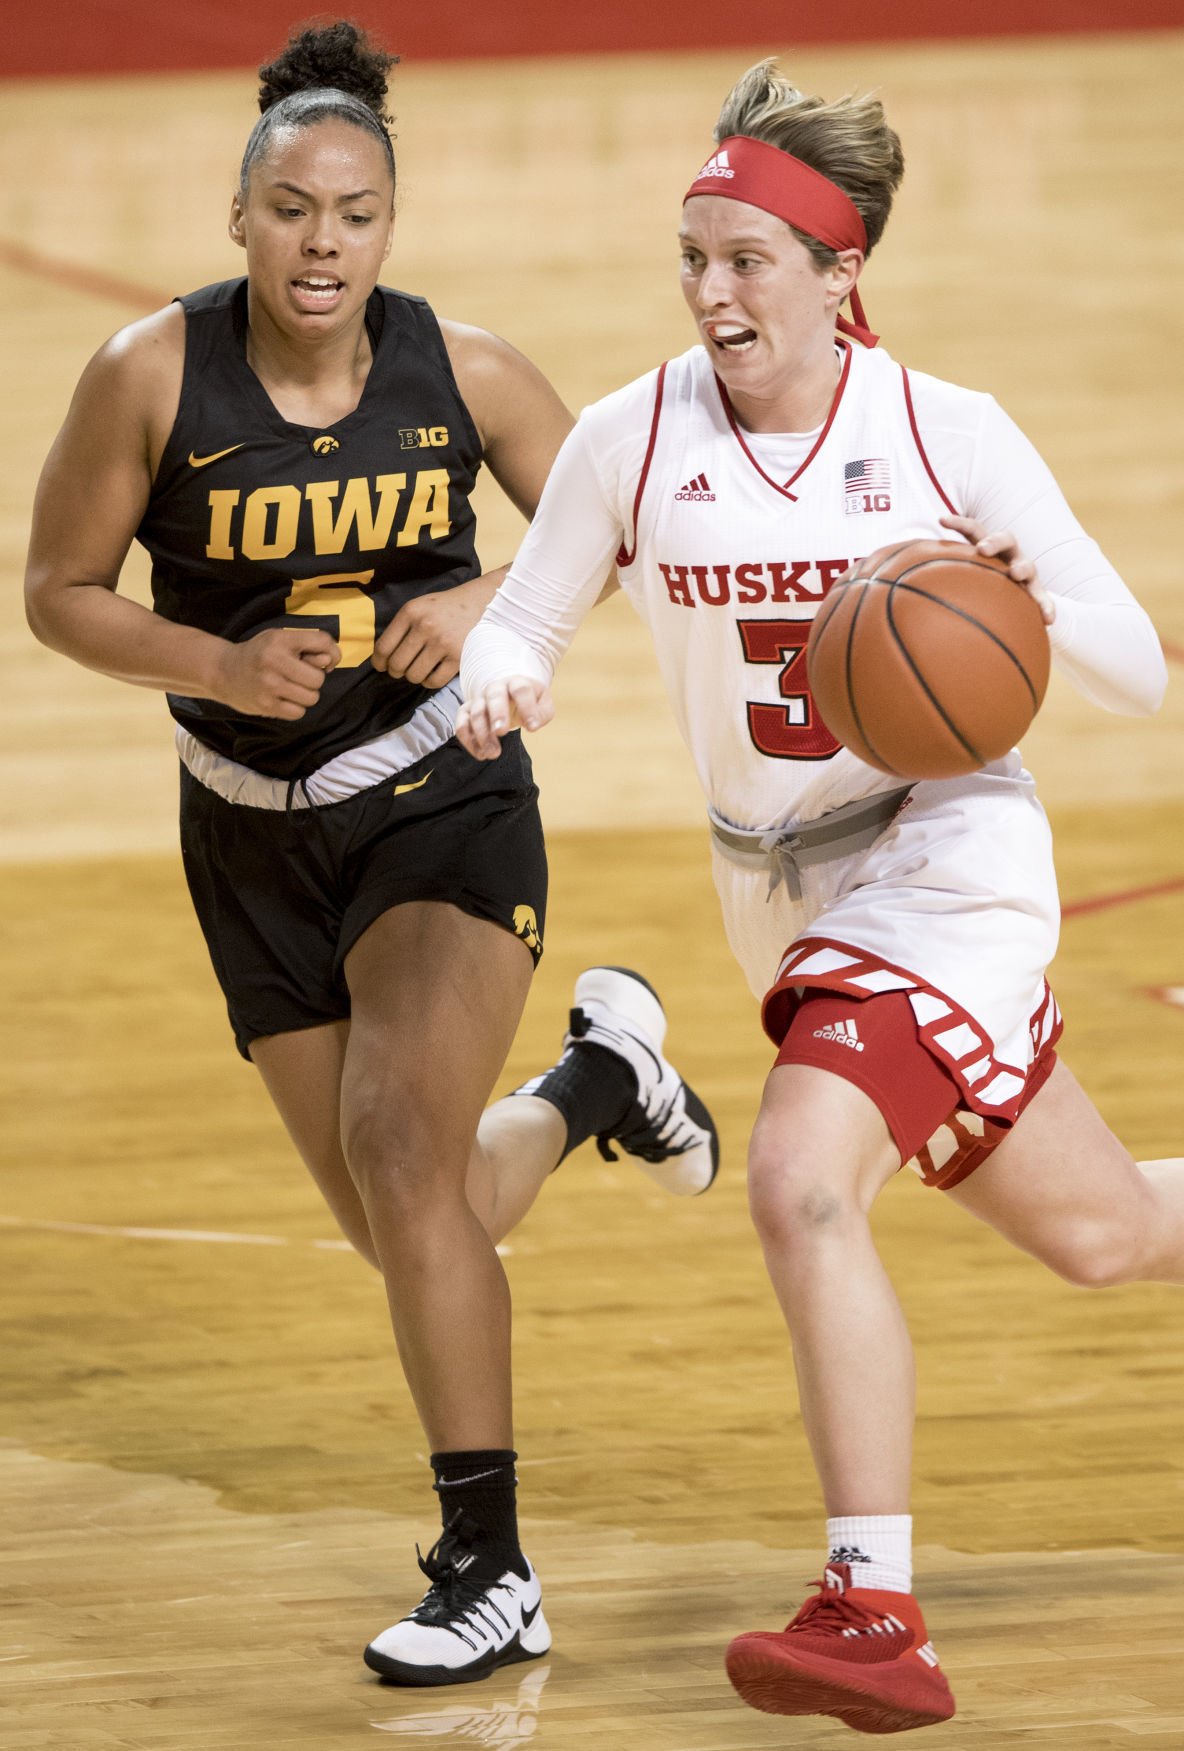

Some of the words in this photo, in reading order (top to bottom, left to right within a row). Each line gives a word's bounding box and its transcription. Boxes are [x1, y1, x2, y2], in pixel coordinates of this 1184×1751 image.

[205, 468, 452, 560] IOWA
[674, 489, 716, 502] adidas
[657, 556, 868, 608] HUSKE
[284, 569, 376, 668] 5
[813, 1029, 865, 1052] adidas
